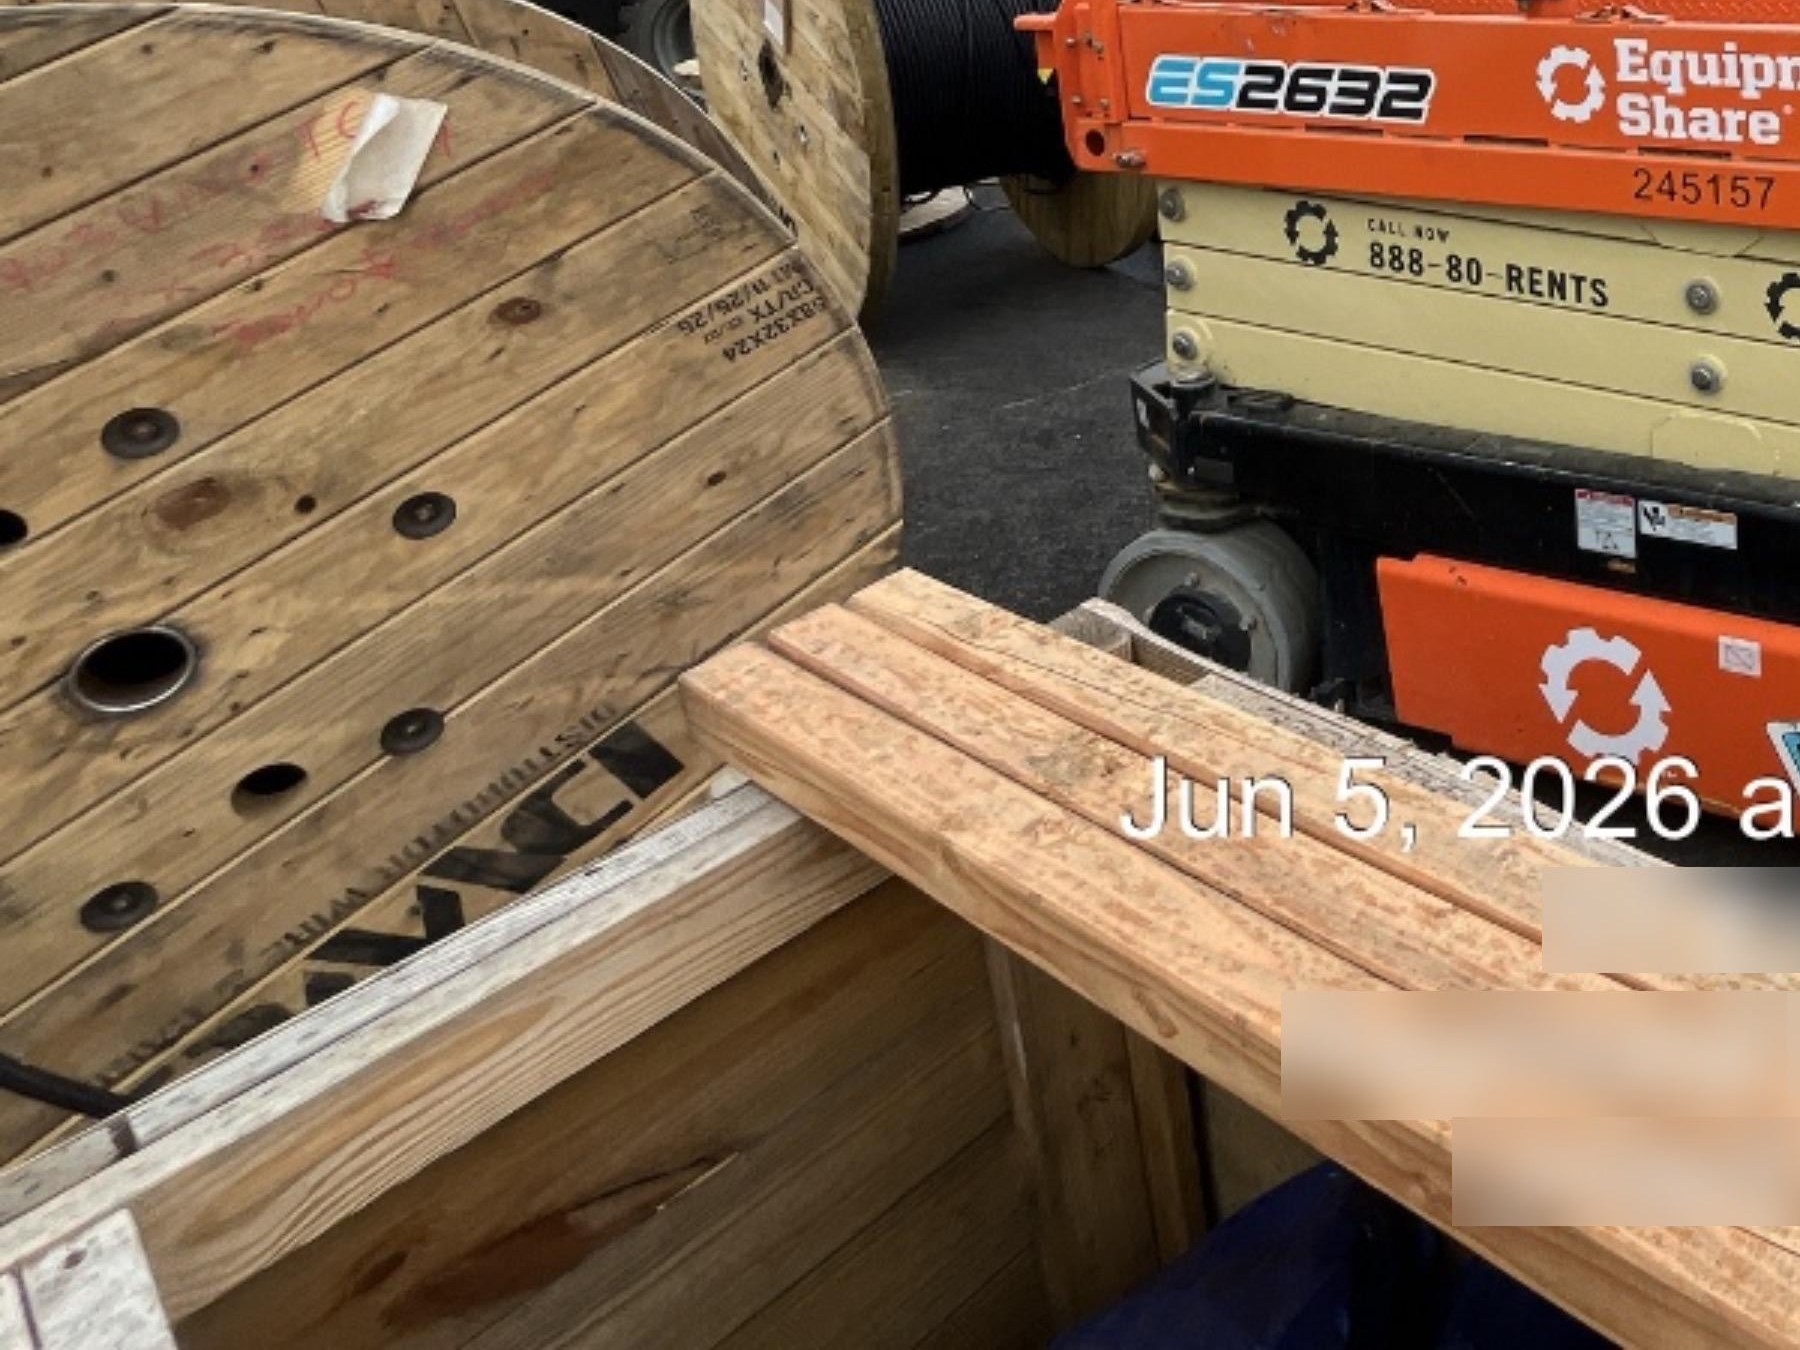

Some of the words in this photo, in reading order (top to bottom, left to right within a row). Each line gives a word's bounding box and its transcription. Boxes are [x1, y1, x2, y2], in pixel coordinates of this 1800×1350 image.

[1147, 55, 1434, 122] ES2632
[1617, 92, 1782, 145] Share
[1632, 167, 1775, 210] 245157
[1368, 218, 1405, 238] CALL
[1415, 224, 1450, 243] NOW
[1369, 242, 1609, 307] 888-80-RENTS
